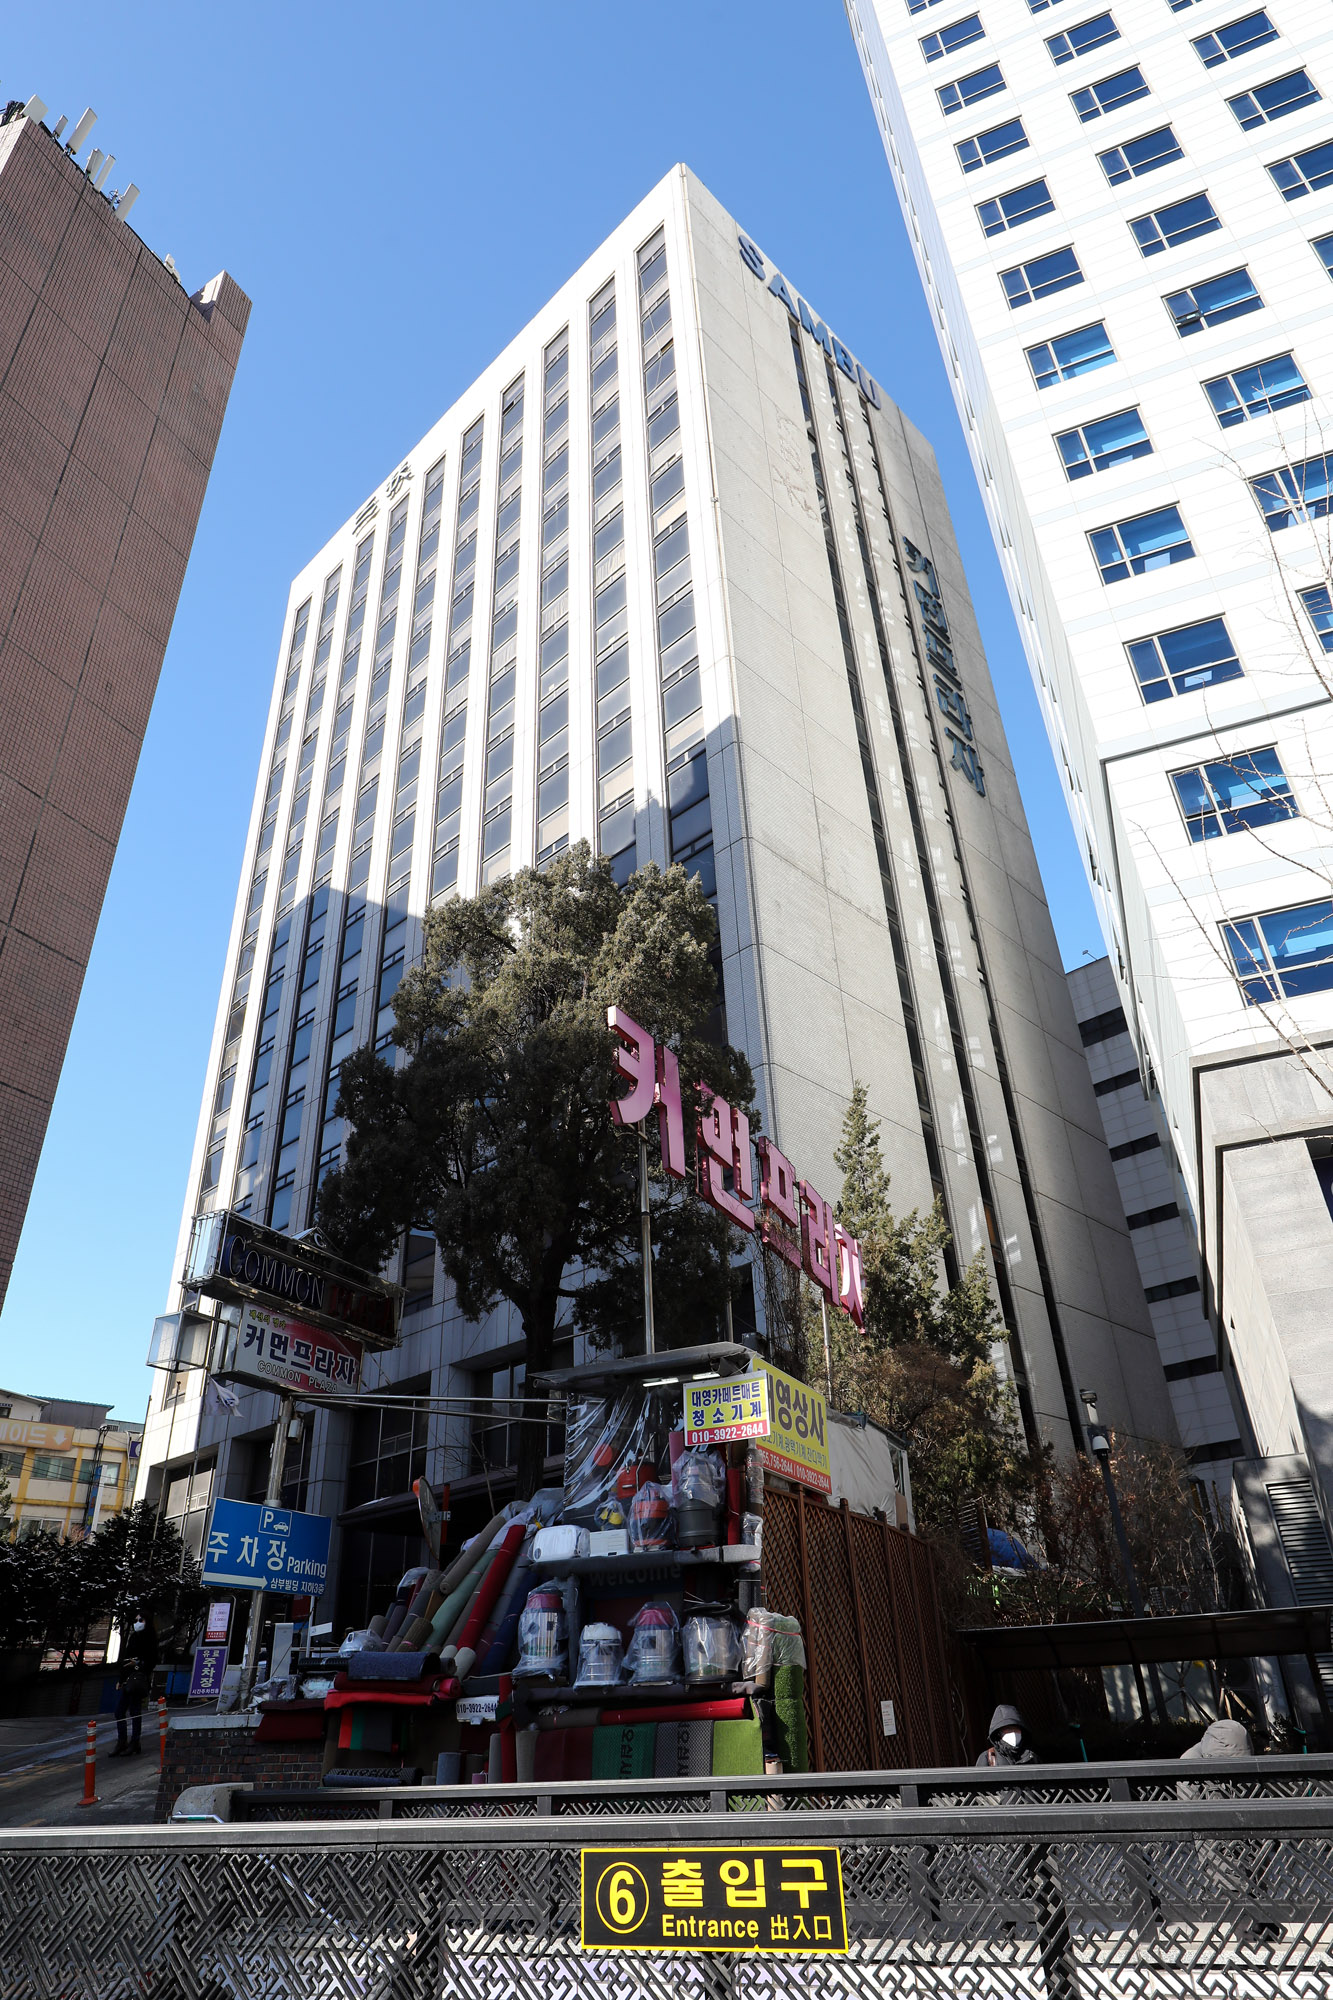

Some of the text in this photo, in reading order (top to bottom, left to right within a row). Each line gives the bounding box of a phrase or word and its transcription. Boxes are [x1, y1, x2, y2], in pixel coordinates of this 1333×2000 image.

[738, 234, 882, 411] SAMBU
[221, 1233, 325, 1310] COMMON
[243, 1323, 357, 1385] 커먼프라자
[257, 1360, 338, 1394] COMMON PLAZA
[691, 1381, 761, 1407] 대영카페트매트
[691, 1422, 764, 1444] 010-3922-2644
[263, 1510, 275, 1529] P
[287, 1556, 327, 1579] Parking
[270, 1577, 299, 1592] 삼부빌딩
[200, 1657, 216, 1688] 주차장
[660, 1858, 828, 1909] 출입구
[661, 1913, 833, 1941] Entrance 出入口
